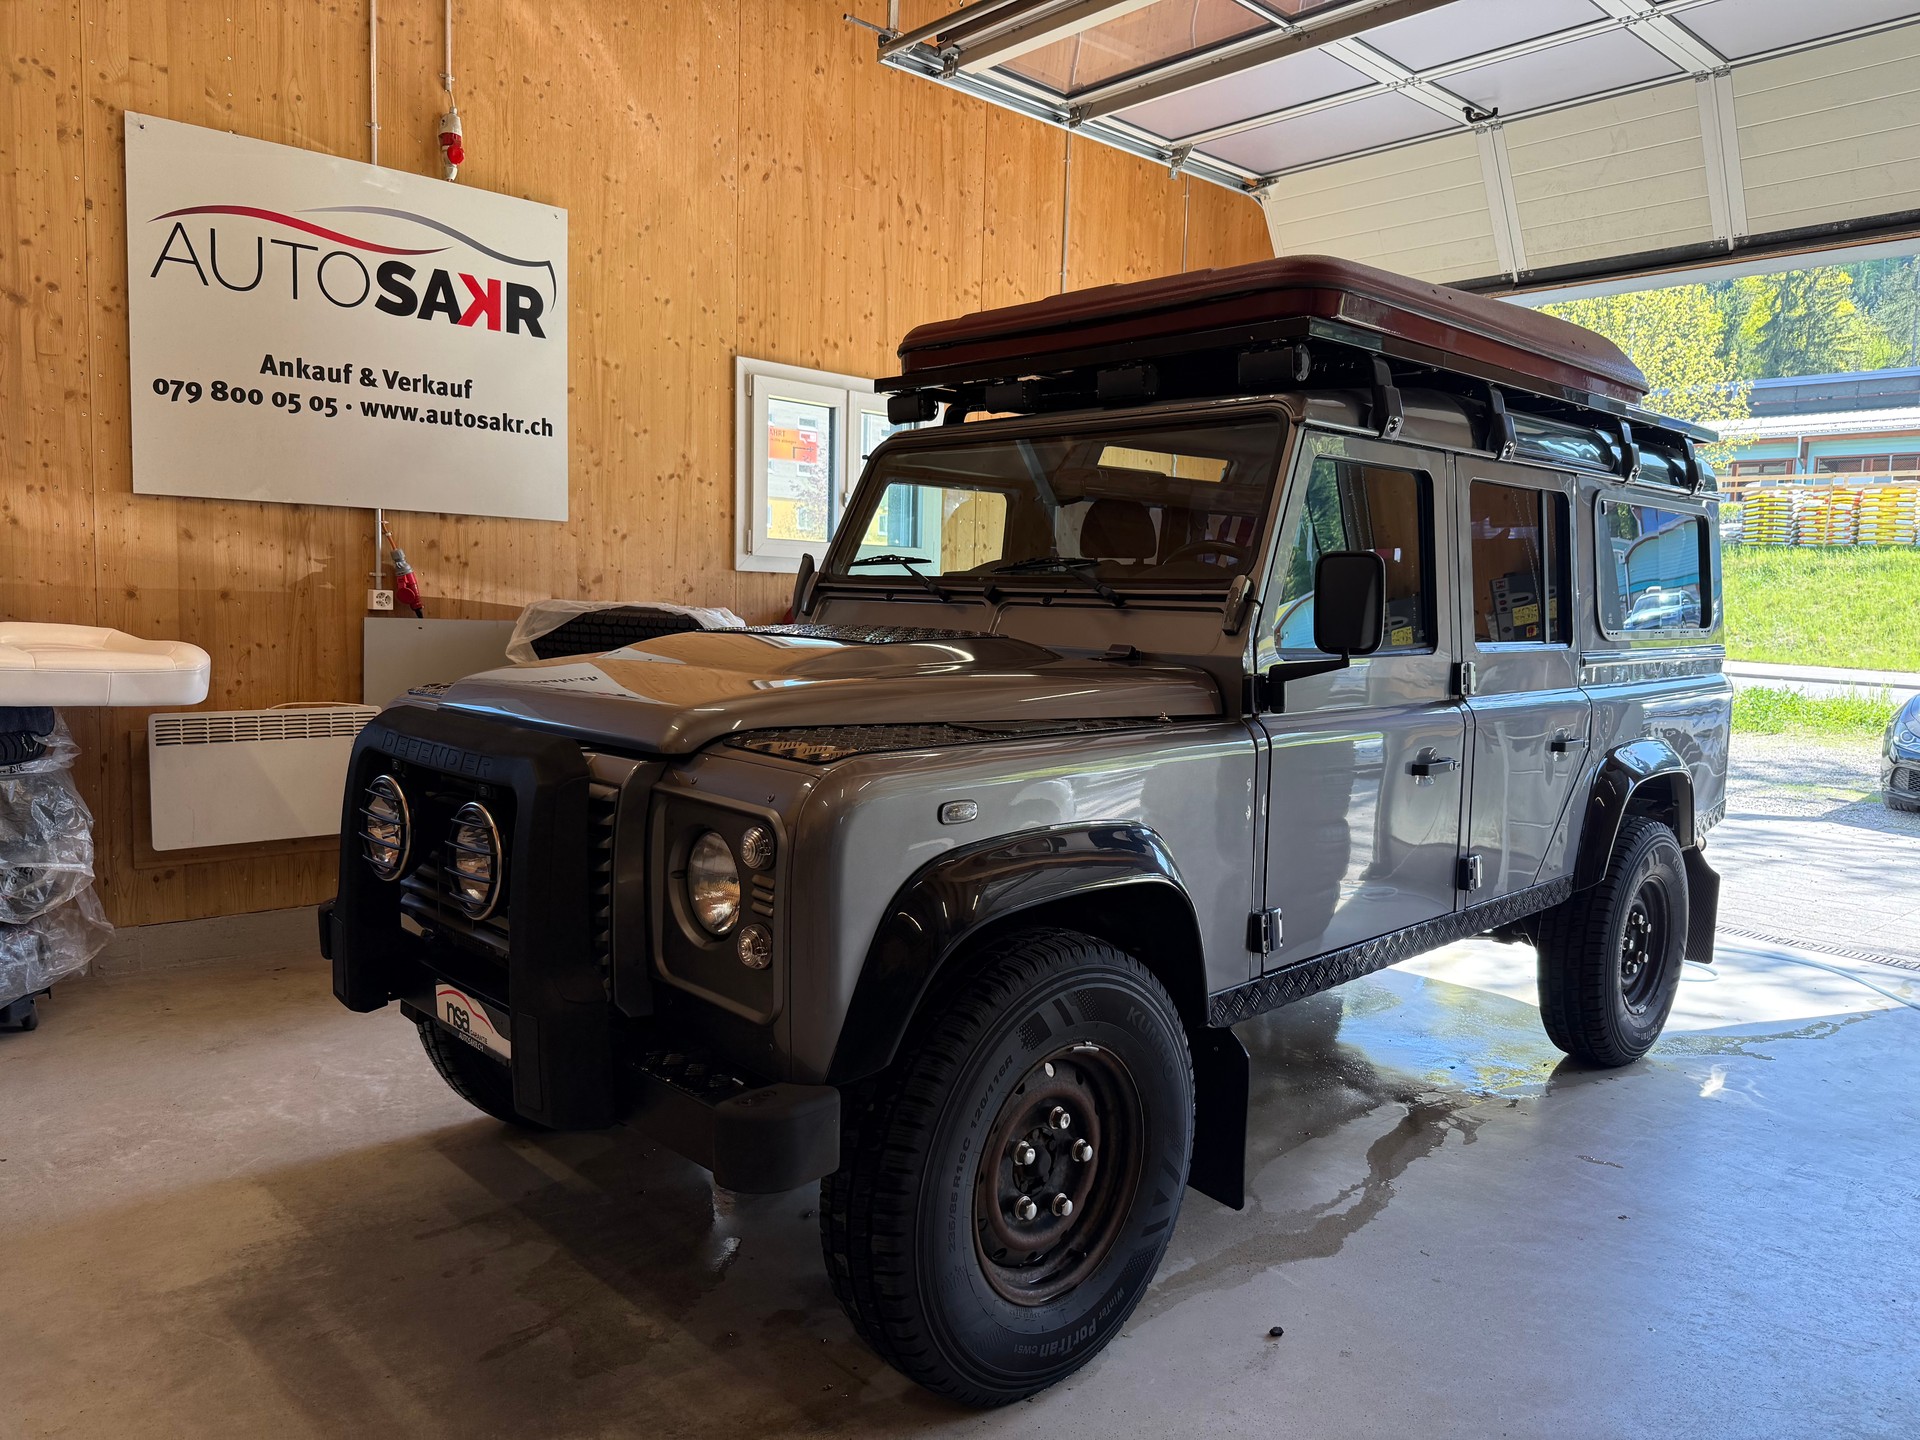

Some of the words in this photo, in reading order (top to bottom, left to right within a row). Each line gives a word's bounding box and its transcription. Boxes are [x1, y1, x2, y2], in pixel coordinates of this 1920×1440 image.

[151, 221, 547, 338] AUTOSAKR
[260, 353, 353, 385] Ankauf
[359, 367, 378, 388] &
[382, 368, 473, 399] Verkauf
[153, 378, 203, 404] 079
[211, 380, 264, 406] 800
[271, 391, 302, 414] 05
[308, 395, 338, 418] 05
[360, 401, 553, 437] www.autosakr.ch
[382, 731, 494, 777] DEFENDER
[446, 1001, 470, 1034] nsa
